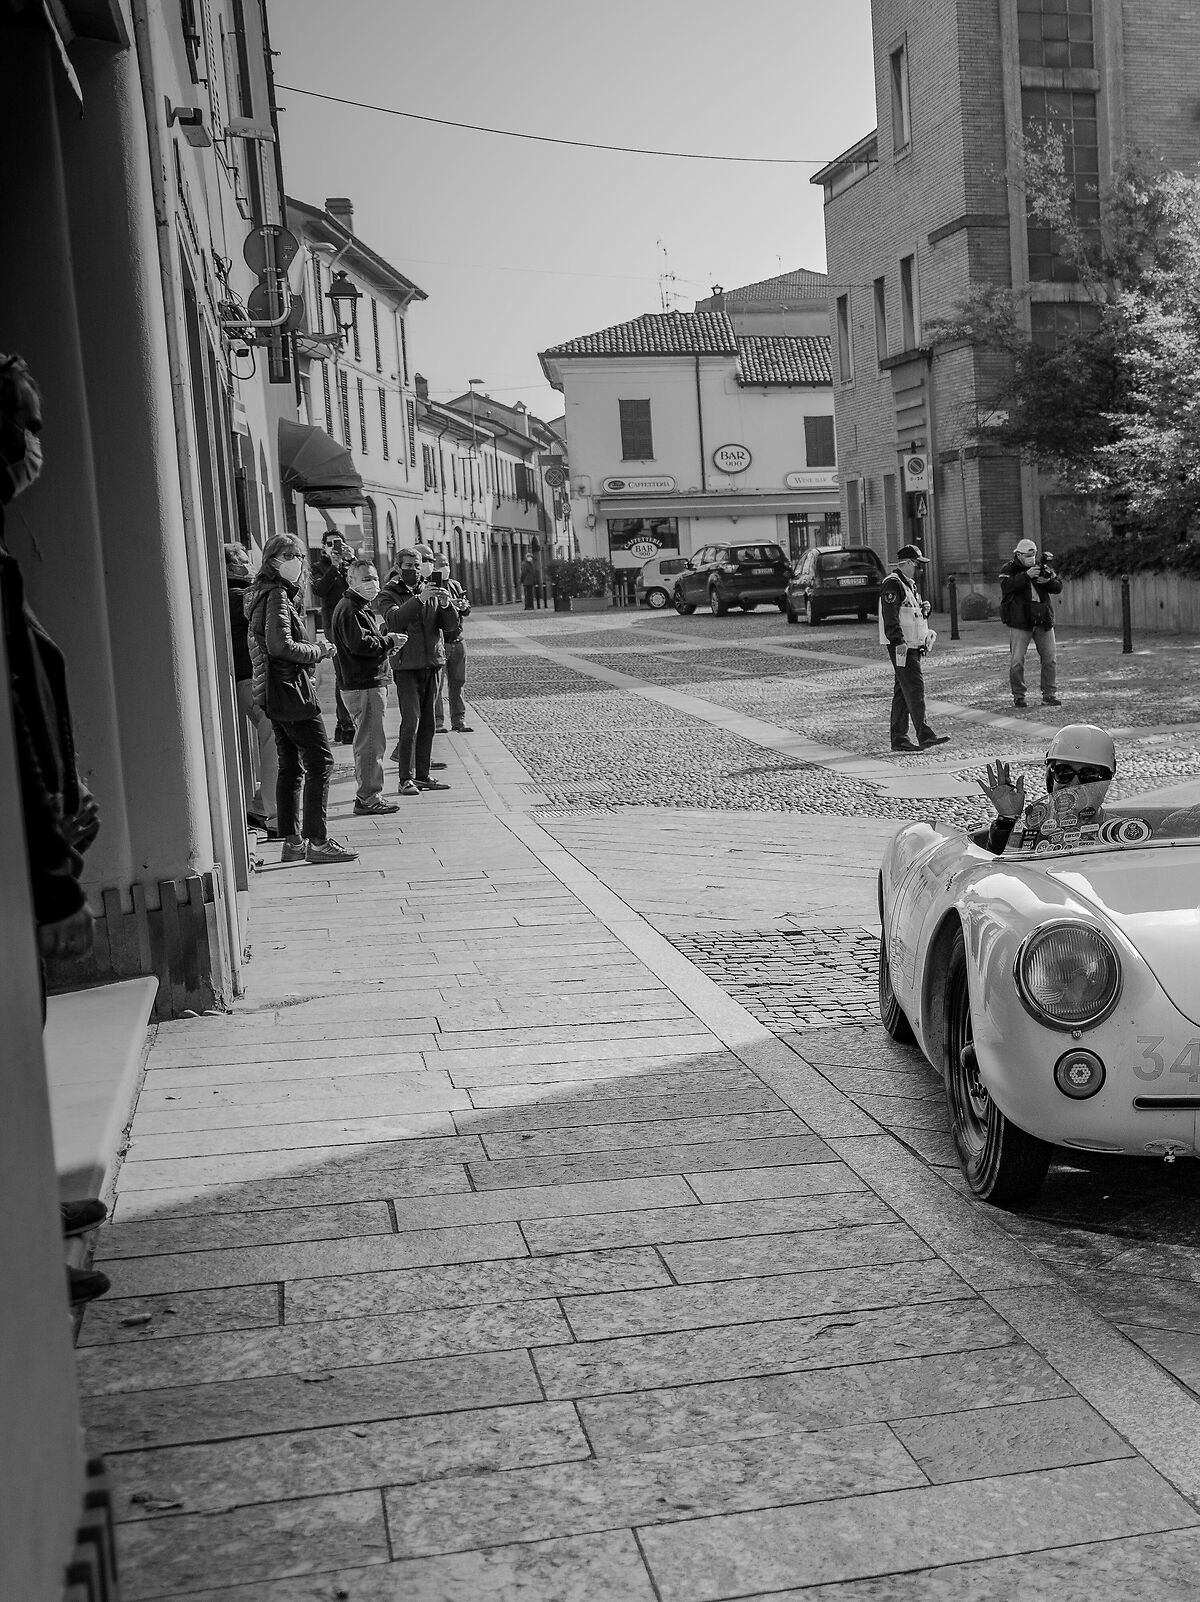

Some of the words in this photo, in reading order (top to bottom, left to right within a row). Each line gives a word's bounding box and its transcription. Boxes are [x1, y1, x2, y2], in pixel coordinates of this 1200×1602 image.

[720, 451, 746, 460] BAR
[624, 536, 664, 550] CAFFETTERIA
[635, 545, 654, 553] BAR
